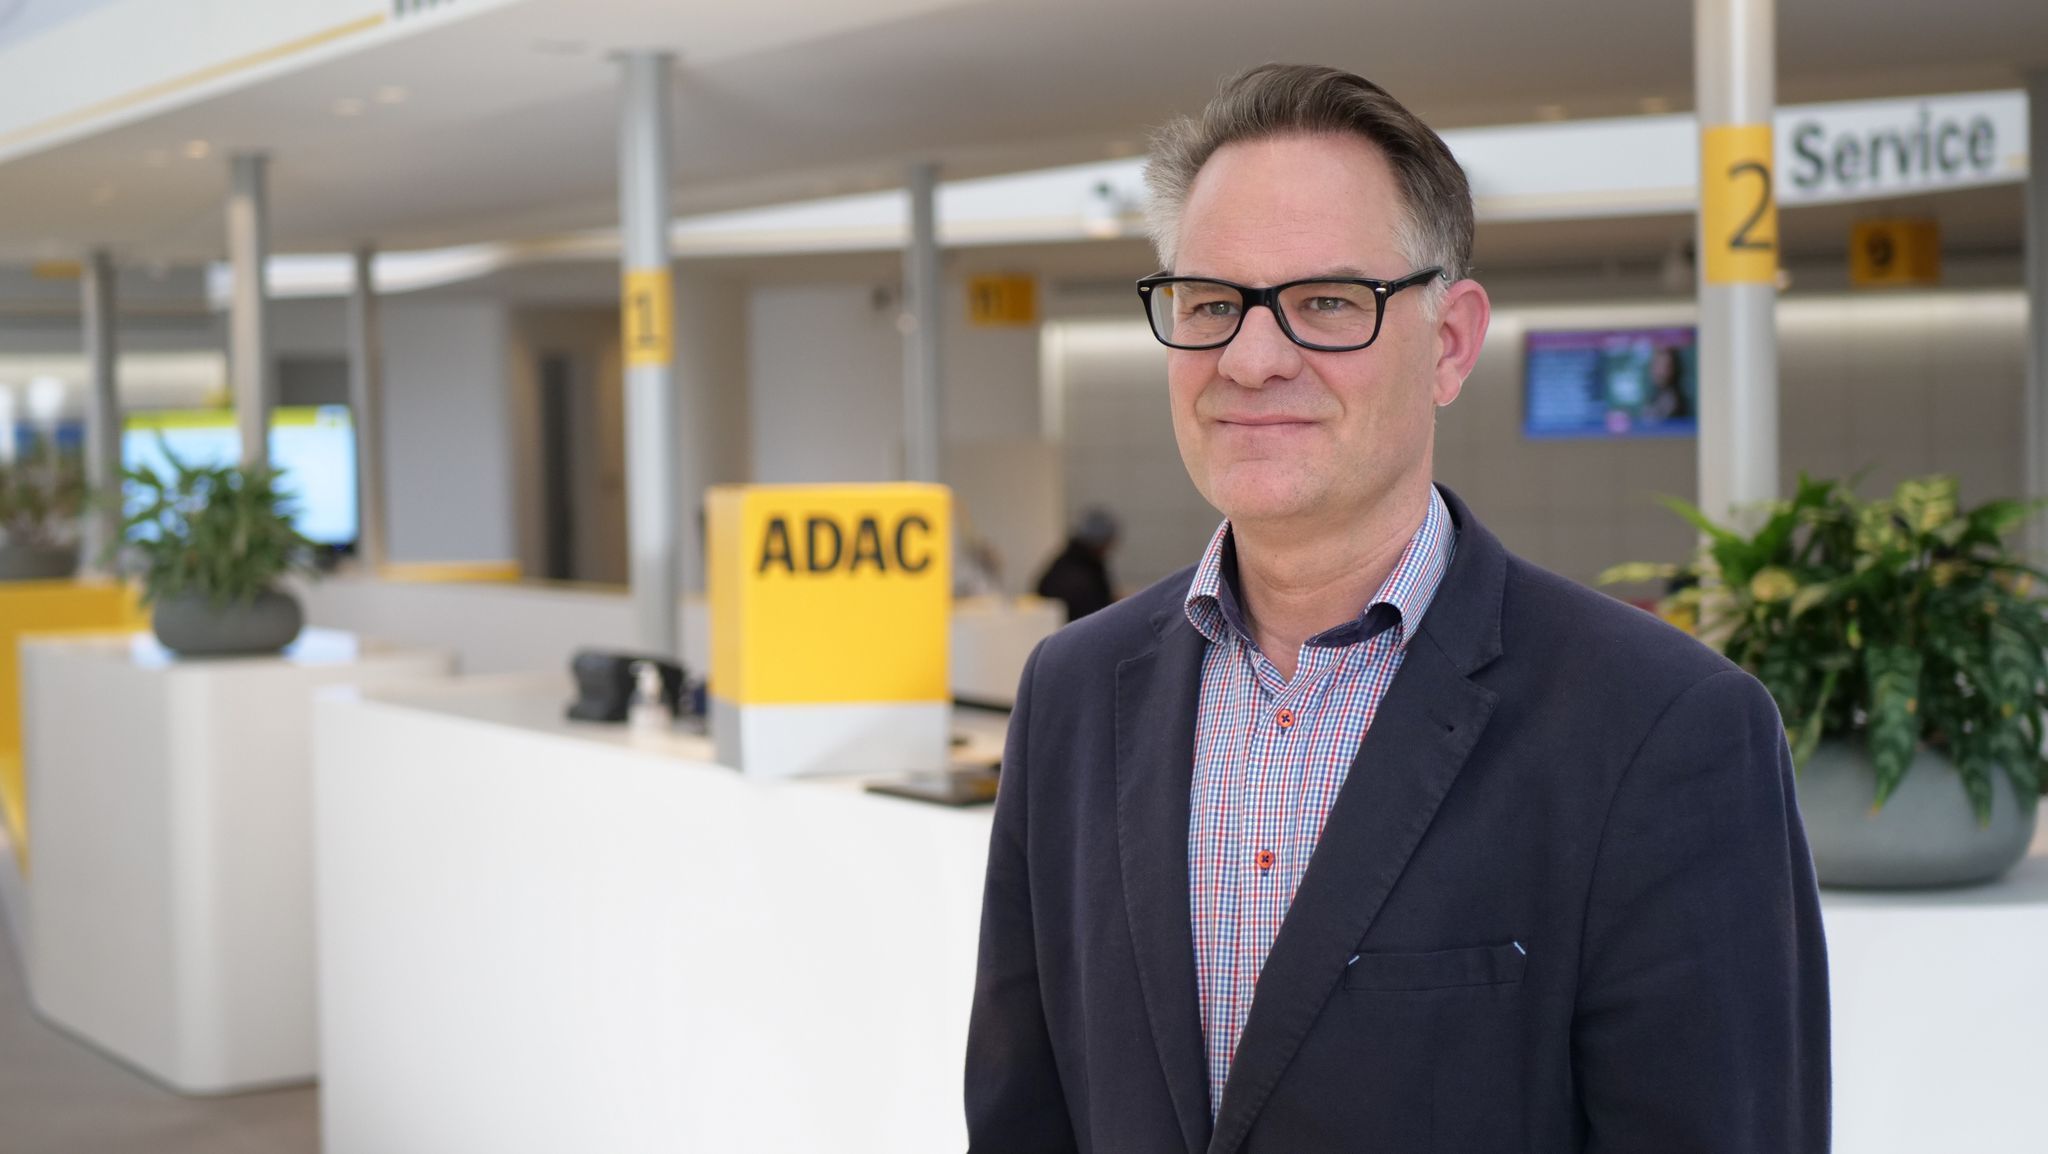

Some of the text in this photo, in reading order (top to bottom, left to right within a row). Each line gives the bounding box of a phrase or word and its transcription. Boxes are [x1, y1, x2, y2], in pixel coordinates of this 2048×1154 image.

[1789, 102, 1995, 189] Service
[1728, 161, 1775, 250] 2
[628, 291, 662, 347] 1
[757, 514, 933, 574] ADAC
